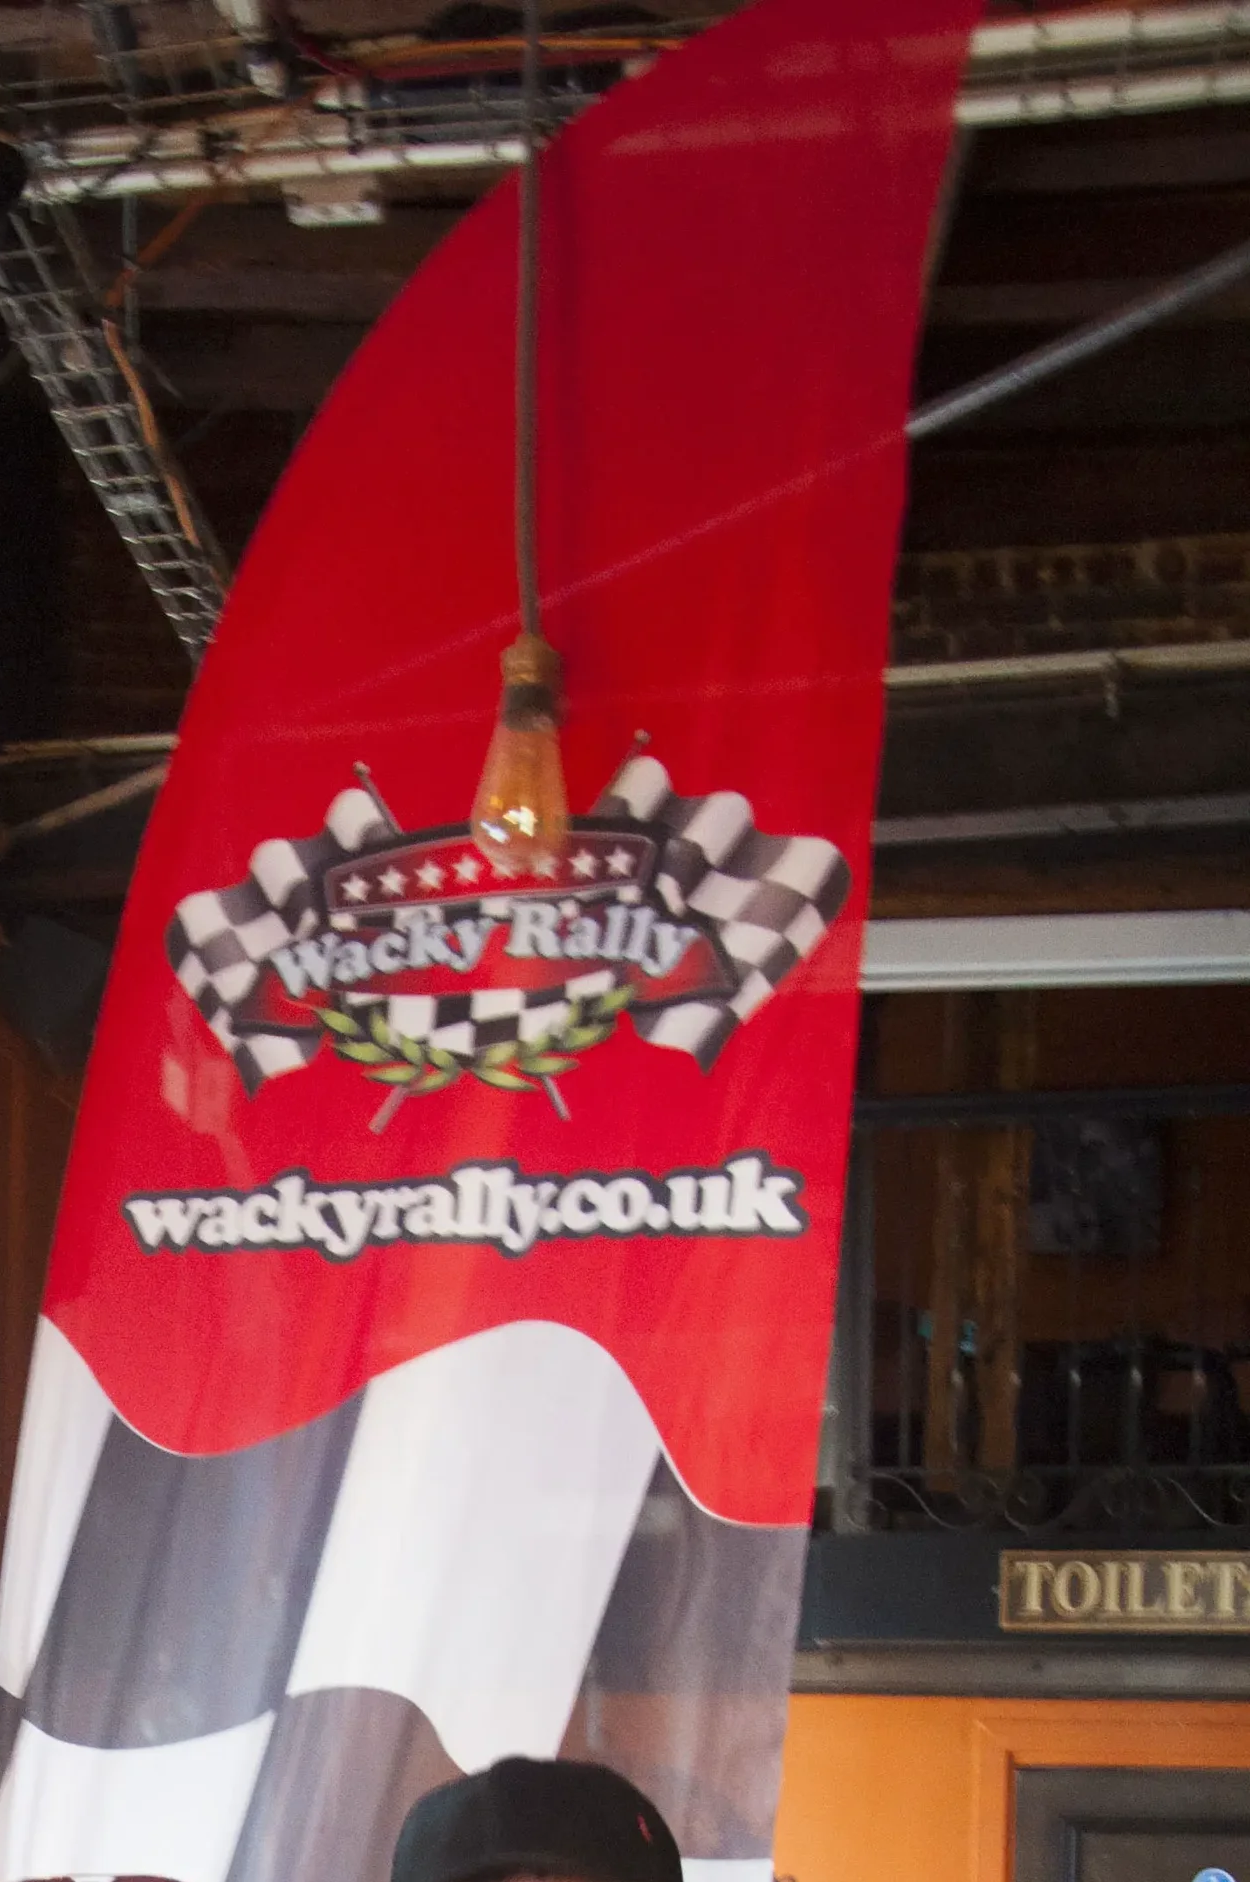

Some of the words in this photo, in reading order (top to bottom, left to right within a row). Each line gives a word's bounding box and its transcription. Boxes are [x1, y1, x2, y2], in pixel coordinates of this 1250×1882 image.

[269, 903, 496, 998] Wacky
[502, 901, 702, 979] Rally
[125, 1154, 804, 1256] wackyrally.co.uk
